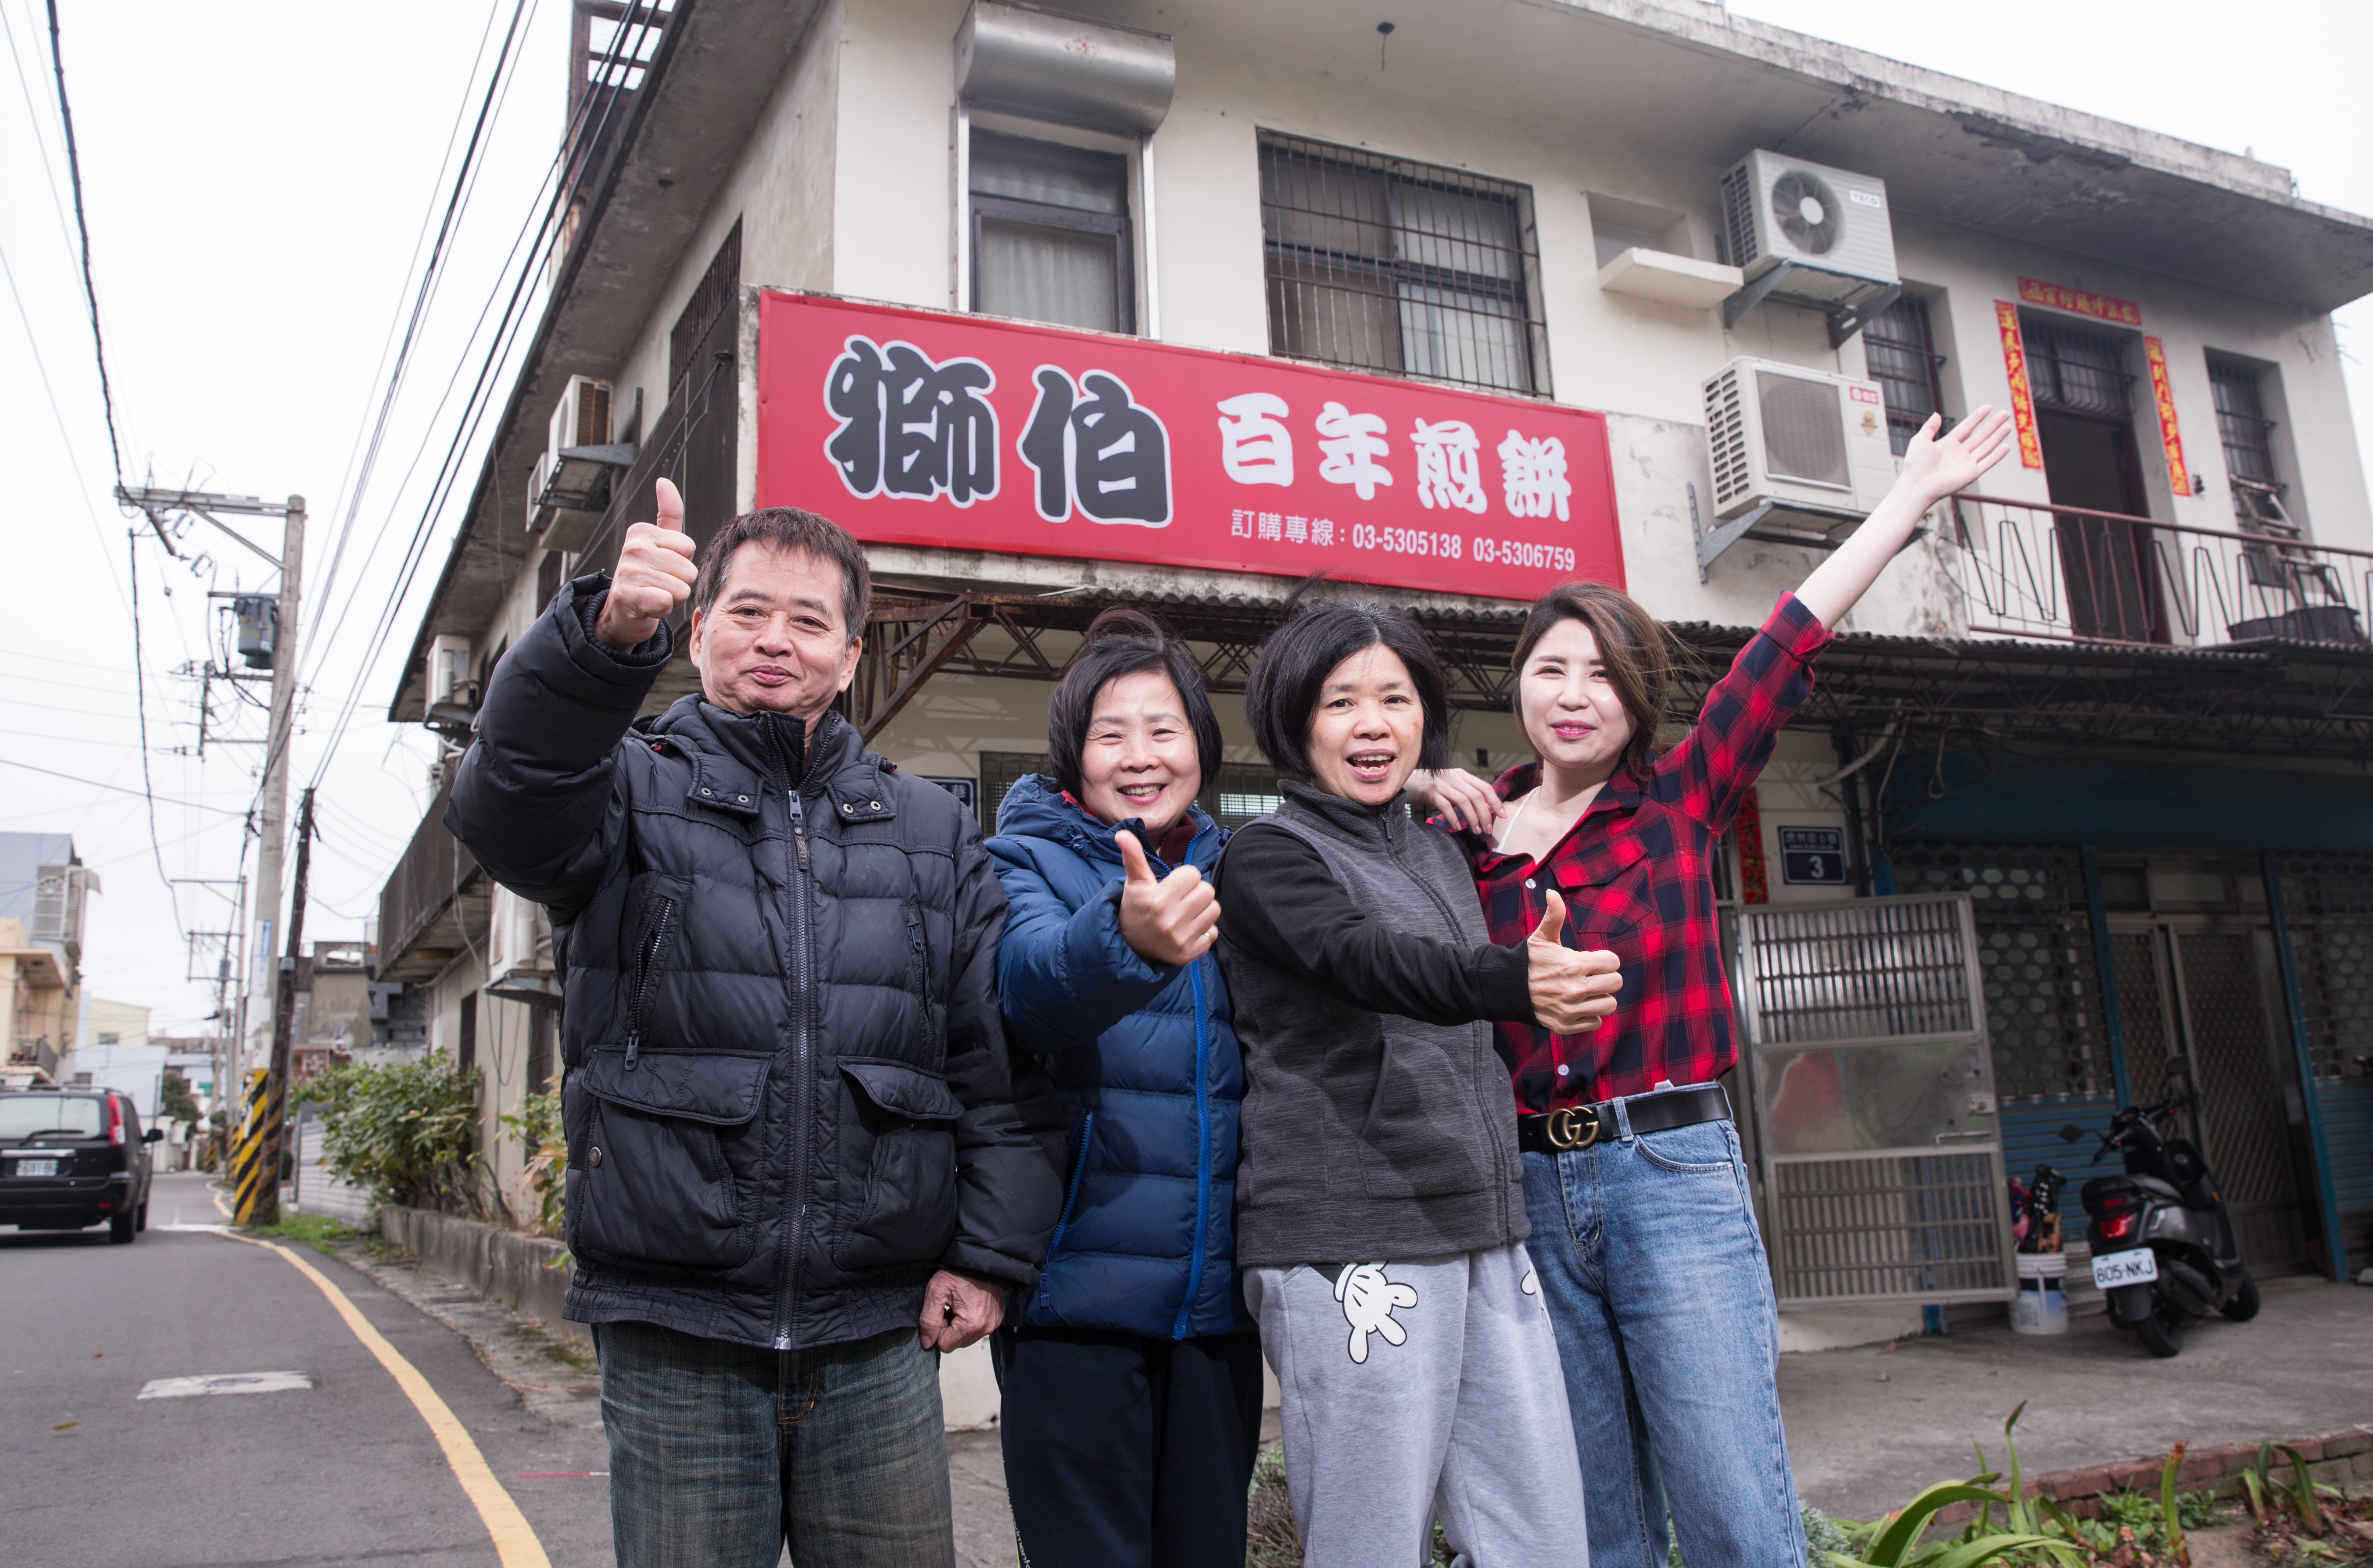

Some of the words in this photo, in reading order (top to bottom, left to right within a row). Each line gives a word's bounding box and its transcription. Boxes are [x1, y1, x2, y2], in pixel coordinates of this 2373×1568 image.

[824, 334, 1173, 528] 獅伯
[1217, 392, 1572, 522] 百年煎餅
[1353, 523, 1462, 560] 03-5305138
[1473, 537, 1575, 572] 03-5306759
[798, 840, 807, 859] ESPRIT
[1810, 855, 1825, 878] 3
